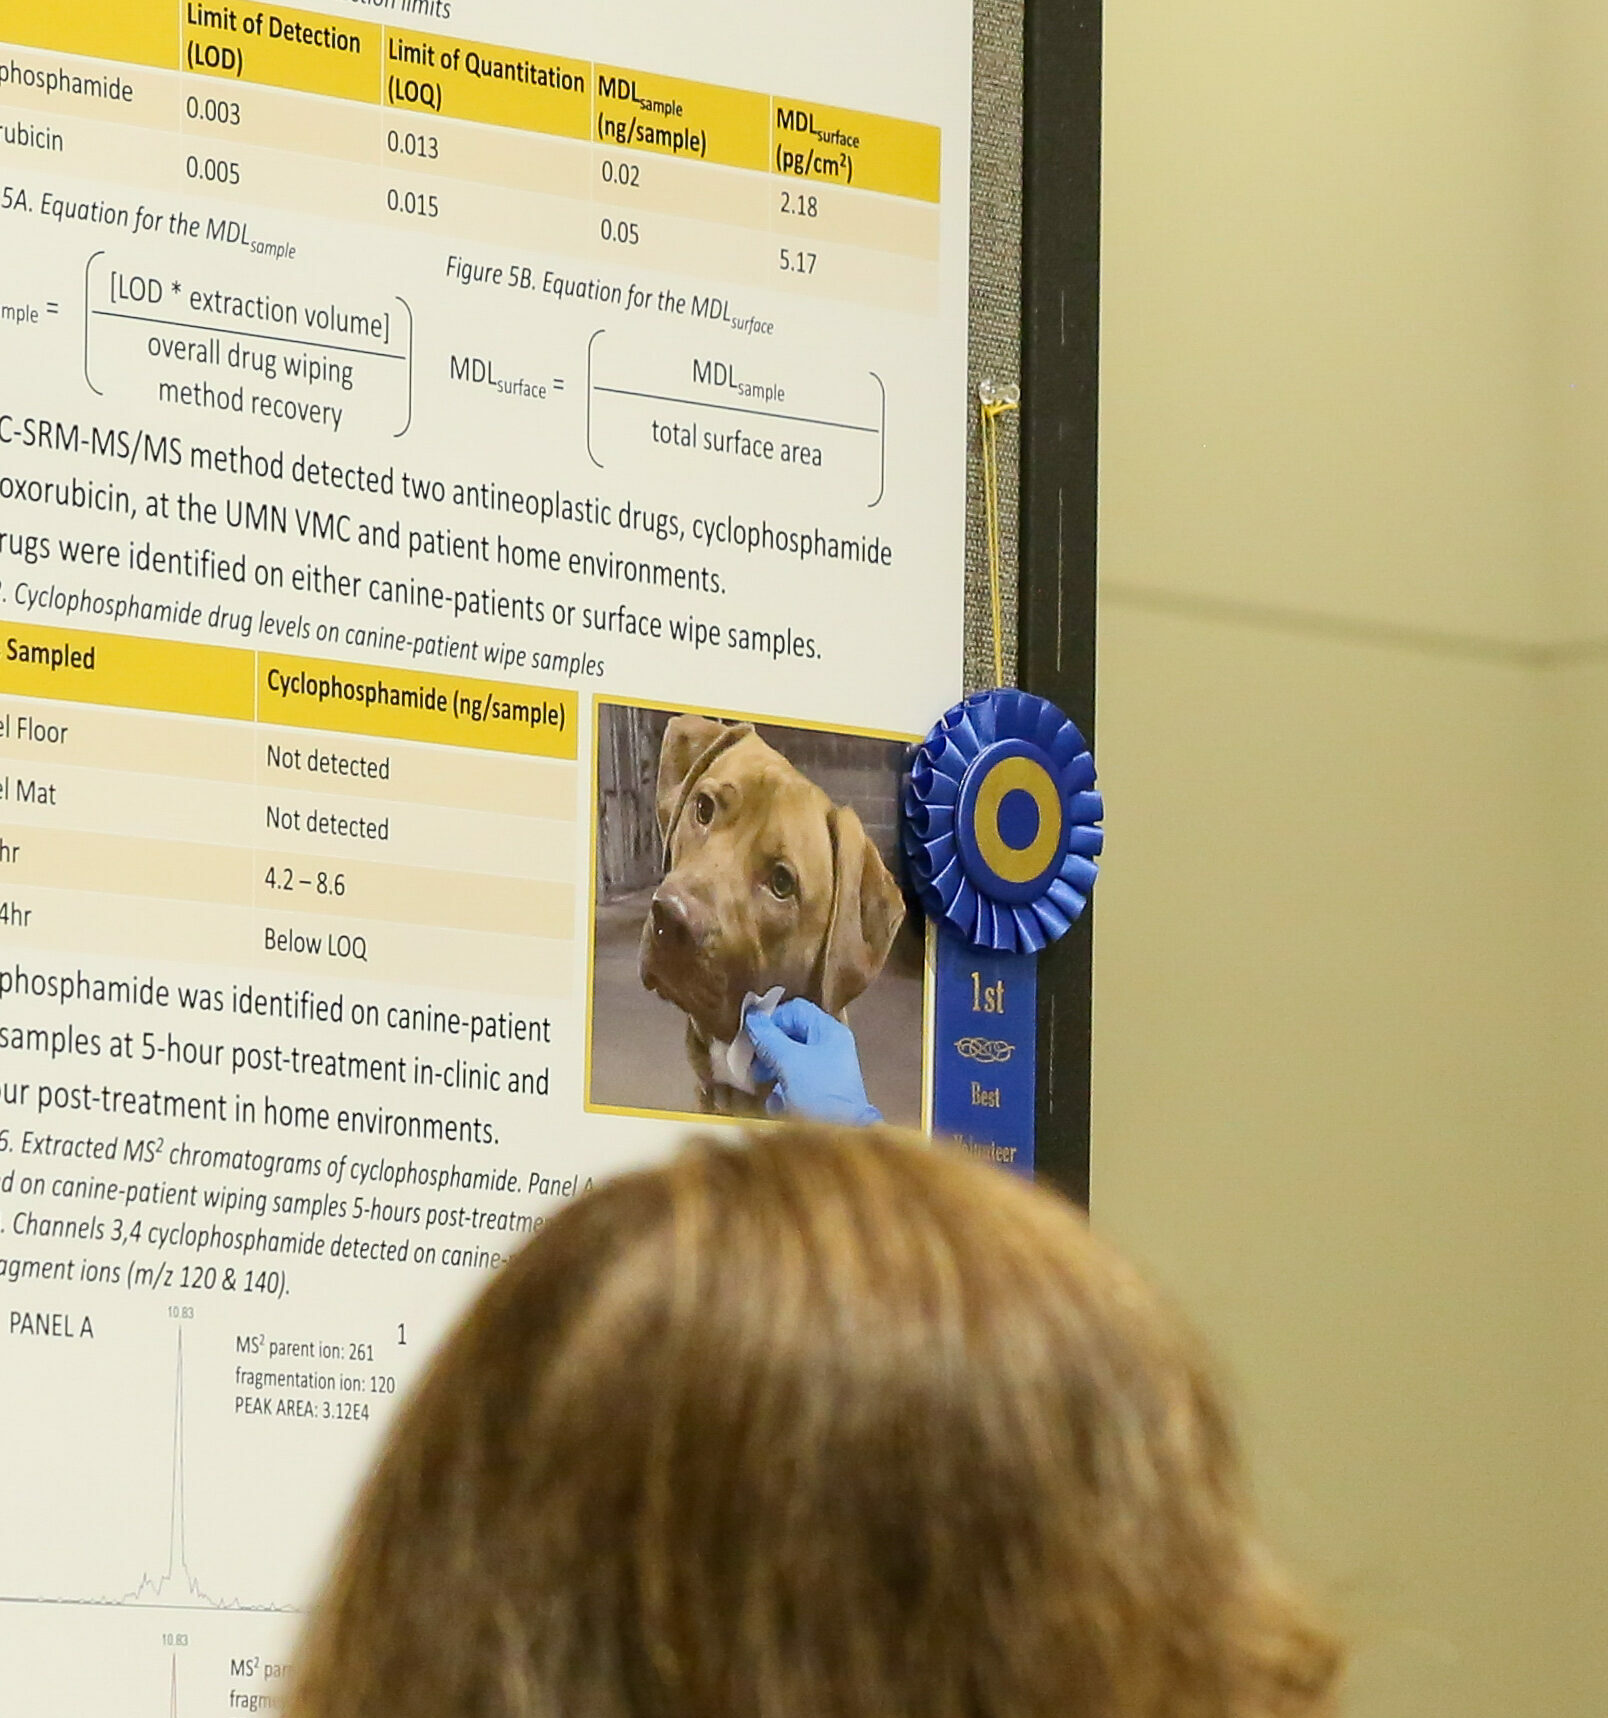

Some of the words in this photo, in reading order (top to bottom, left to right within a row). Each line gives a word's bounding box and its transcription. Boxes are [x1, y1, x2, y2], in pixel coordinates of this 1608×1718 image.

[187, 1, 237, 32] Limit
[242, 12, 264, 36] of
[269, 15, 361, 54] Detection
[187, 39, 243, 78] (LOD)
[389, 37, 435, 67] Limit
[440, 47, 461, 71] of
[465, 51, 585, 93] Quantitation
[388, 74, 442, 113] (LOQ)
[186, 95, 241, 126] 0.003
[387, 129, 439, 160] 0.013
[597, 111, 707, 159] (ng/sample)
[186, 155, 240, 185] 0.005
[601, 160, 640, 188] 0.02
[387, 188, 439, 218] 0.015
[780, 191, 818, 218] 2.18
[600, 218, 639, 245] 0.05
[779, 248, 817, 275] 5.17
[6, 637, 95, 672] Sampled
[267, 668, 448, 712] Cyclophosphamide
[453, 689, 565, 732] (ng/sample)
[17, 715, 69, 744] Floor
[267, 744, 302, 771] Not
[307, 748, 390, 781] detected
[16, 778, 57, 806] Mat
[266, 805, 301, 831] Not
[306, 809, 389, 841] detected
[264, 927, 323, 955] Below
[328, 933, 368, 963] LOQ
[970, 971, 1006, 1015] 1st
[970, 1080, 1001, 1109] Best
[10, 1311, 75, 1338] PANEL
[79, 1315, 95, 1339] A
[397, 1322, 407, 1346] 1
[269, 1341, 315, 1360] parent
[318, 1345, 345, 1361] ion:
[348, 1342, 374, 1362] 261
[235, 1365, 336, 1391] fragmentation
[339, 1373, 366, 1393] ion:
[370, 1375, 396, 1394] 120
[235, 1395, 273, 1415] PEAK
[275, 1398, 319, 1418] AREA:
[322, 1401, 370, 1421] 3.12E4
